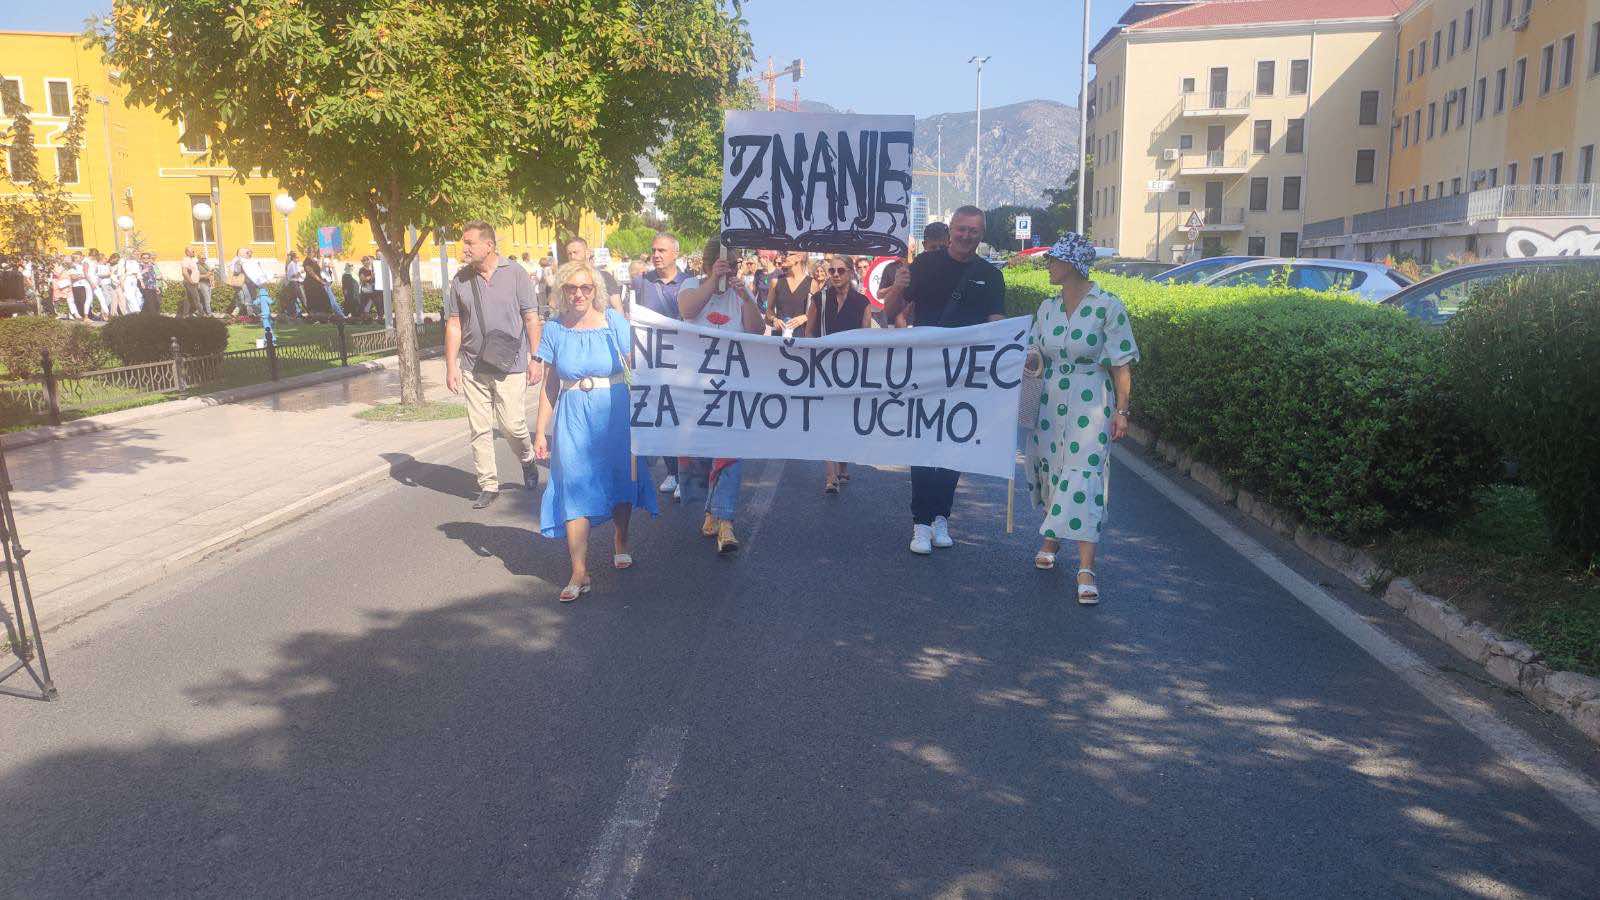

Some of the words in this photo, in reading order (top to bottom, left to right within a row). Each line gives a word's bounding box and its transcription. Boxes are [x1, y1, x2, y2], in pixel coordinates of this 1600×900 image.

[723, 131, 912, 233] ZNANJE
[631, 327, 678, 369] NE
[698, 335, 750, 378] ZA
[942, 330, 1026, 389] VEĆ
[630, 384, 680, 427] ZA
[697, 378, 824, 431] ŽIVOT
[853, 391, 981, 444] UČIMO.
